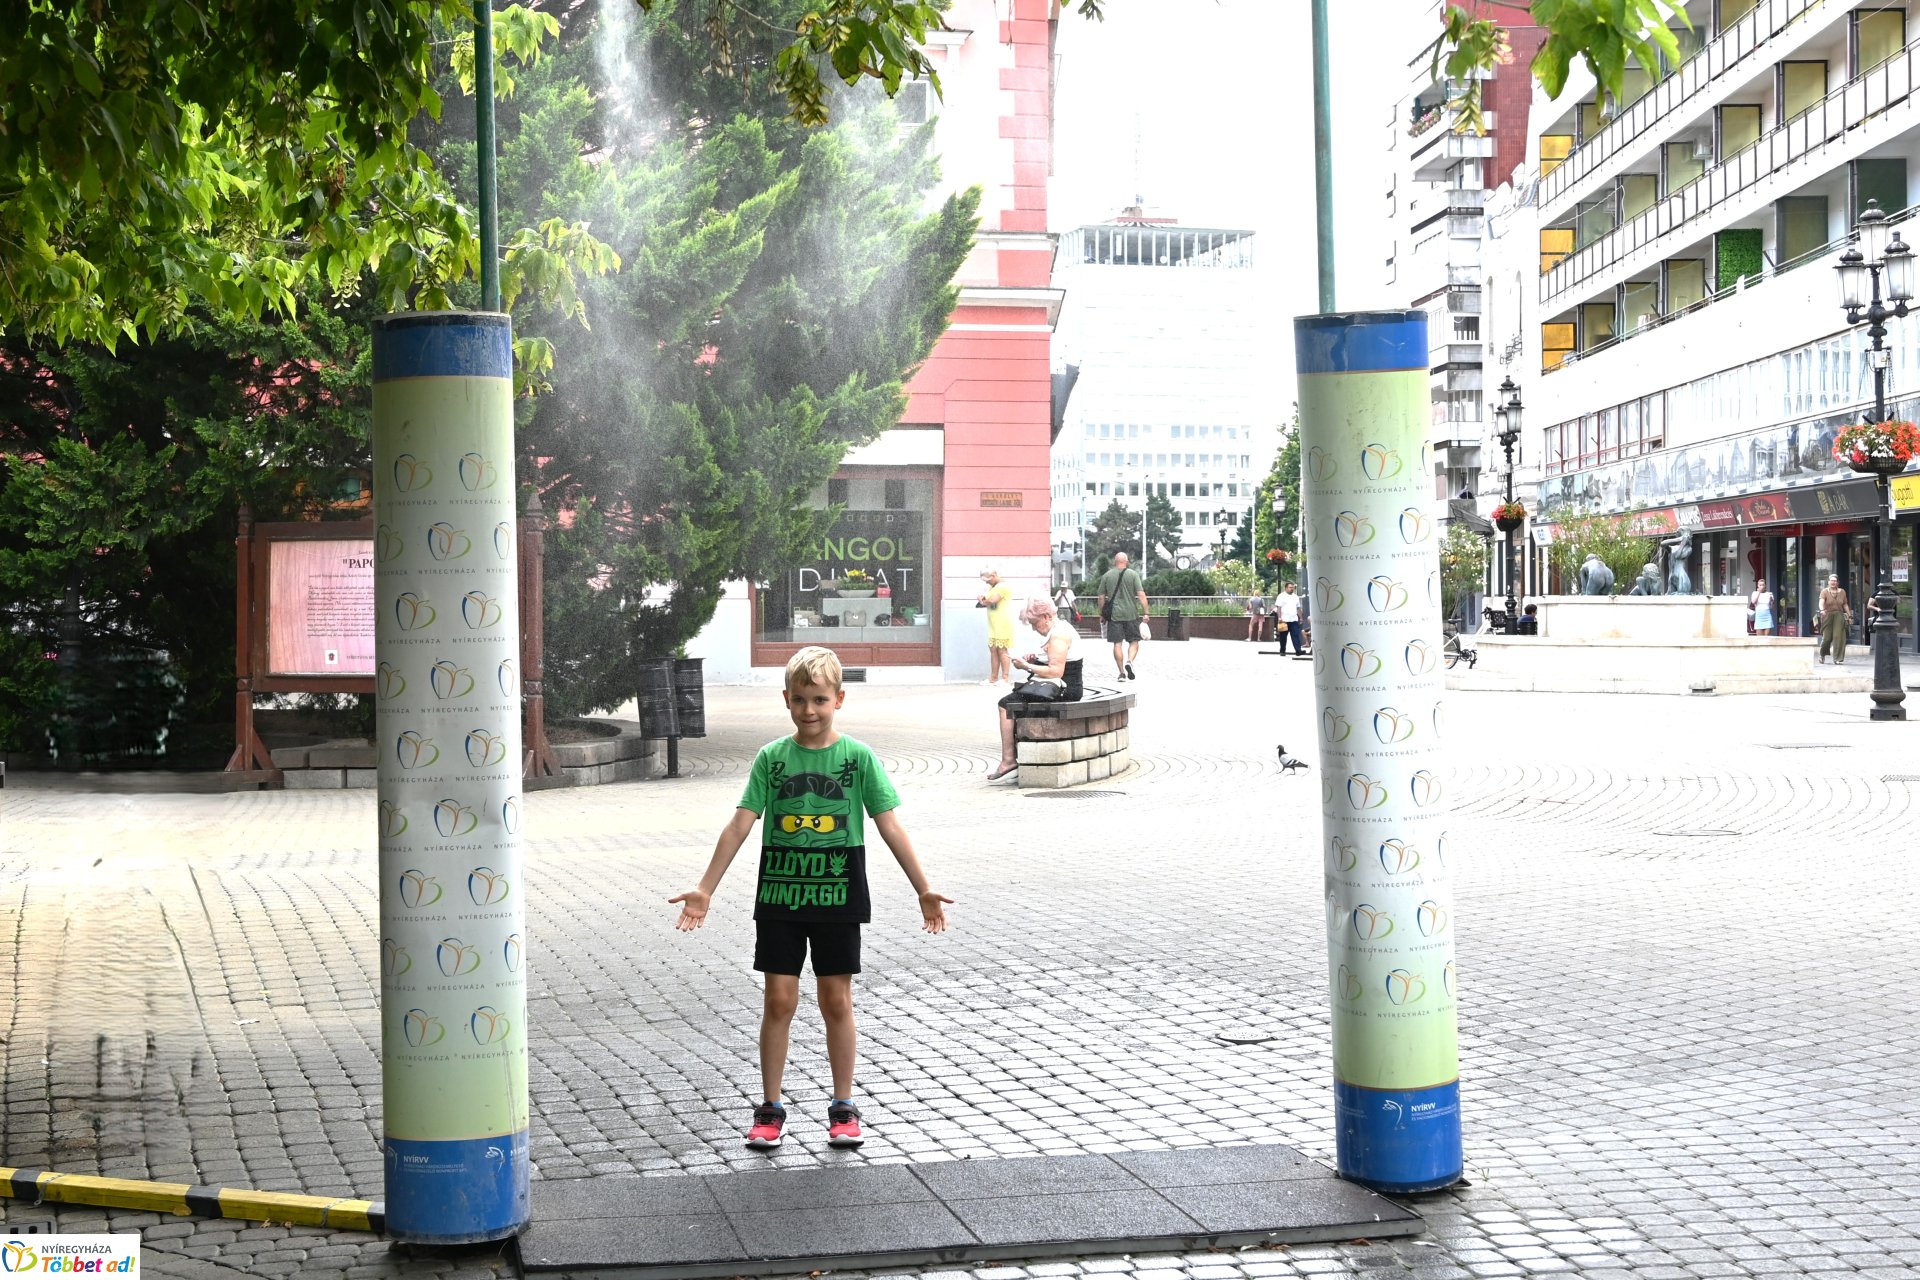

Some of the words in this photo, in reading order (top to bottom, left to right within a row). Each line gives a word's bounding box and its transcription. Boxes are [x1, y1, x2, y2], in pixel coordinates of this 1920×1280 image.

[1353, 486, 1407, 494] NYÍREGYHÁZA
[1328, 553, 1381, 561] NYÍREGYHÁZA
[418, 567, 476, 575] NYÍREGYHÁZA
[799, 568, 914, 592] DIAT
[1359, 618, 1413, 626] NYÍREGYHÁZA
[452, 636, 506, 644] NYÍREGYHÁZA
[1365, 749, 1419, 758] NYÍREGYHÁZA
[389, 776, 444, 784] NYÍREGYHÁZA
[455, 774, 510, 782] NYÍREGYHÁZA
[765, 850, 826, 877] LLOYD
[1371, 880, 1425, 888] NYÍREGYHÁZA
[759, 882, 848, 911] NINJAGO
[392, 914, 447, 922] NYÍREGYHÁZA
[458, 912, 513, 920] NYÍREGYHÁZA
[427, 983, 485, 992] NYÍREGYHÁZA
[1377, 1009, 1431, 1018] NYÍREGYHÁZA
[397, 1053, 450, 1062] NYÍREGYHÁZA
[461, 1050, 514, 1060] NYÍREGYHÁZA
[403, 1154, 430, 1164] NYÍRVV
